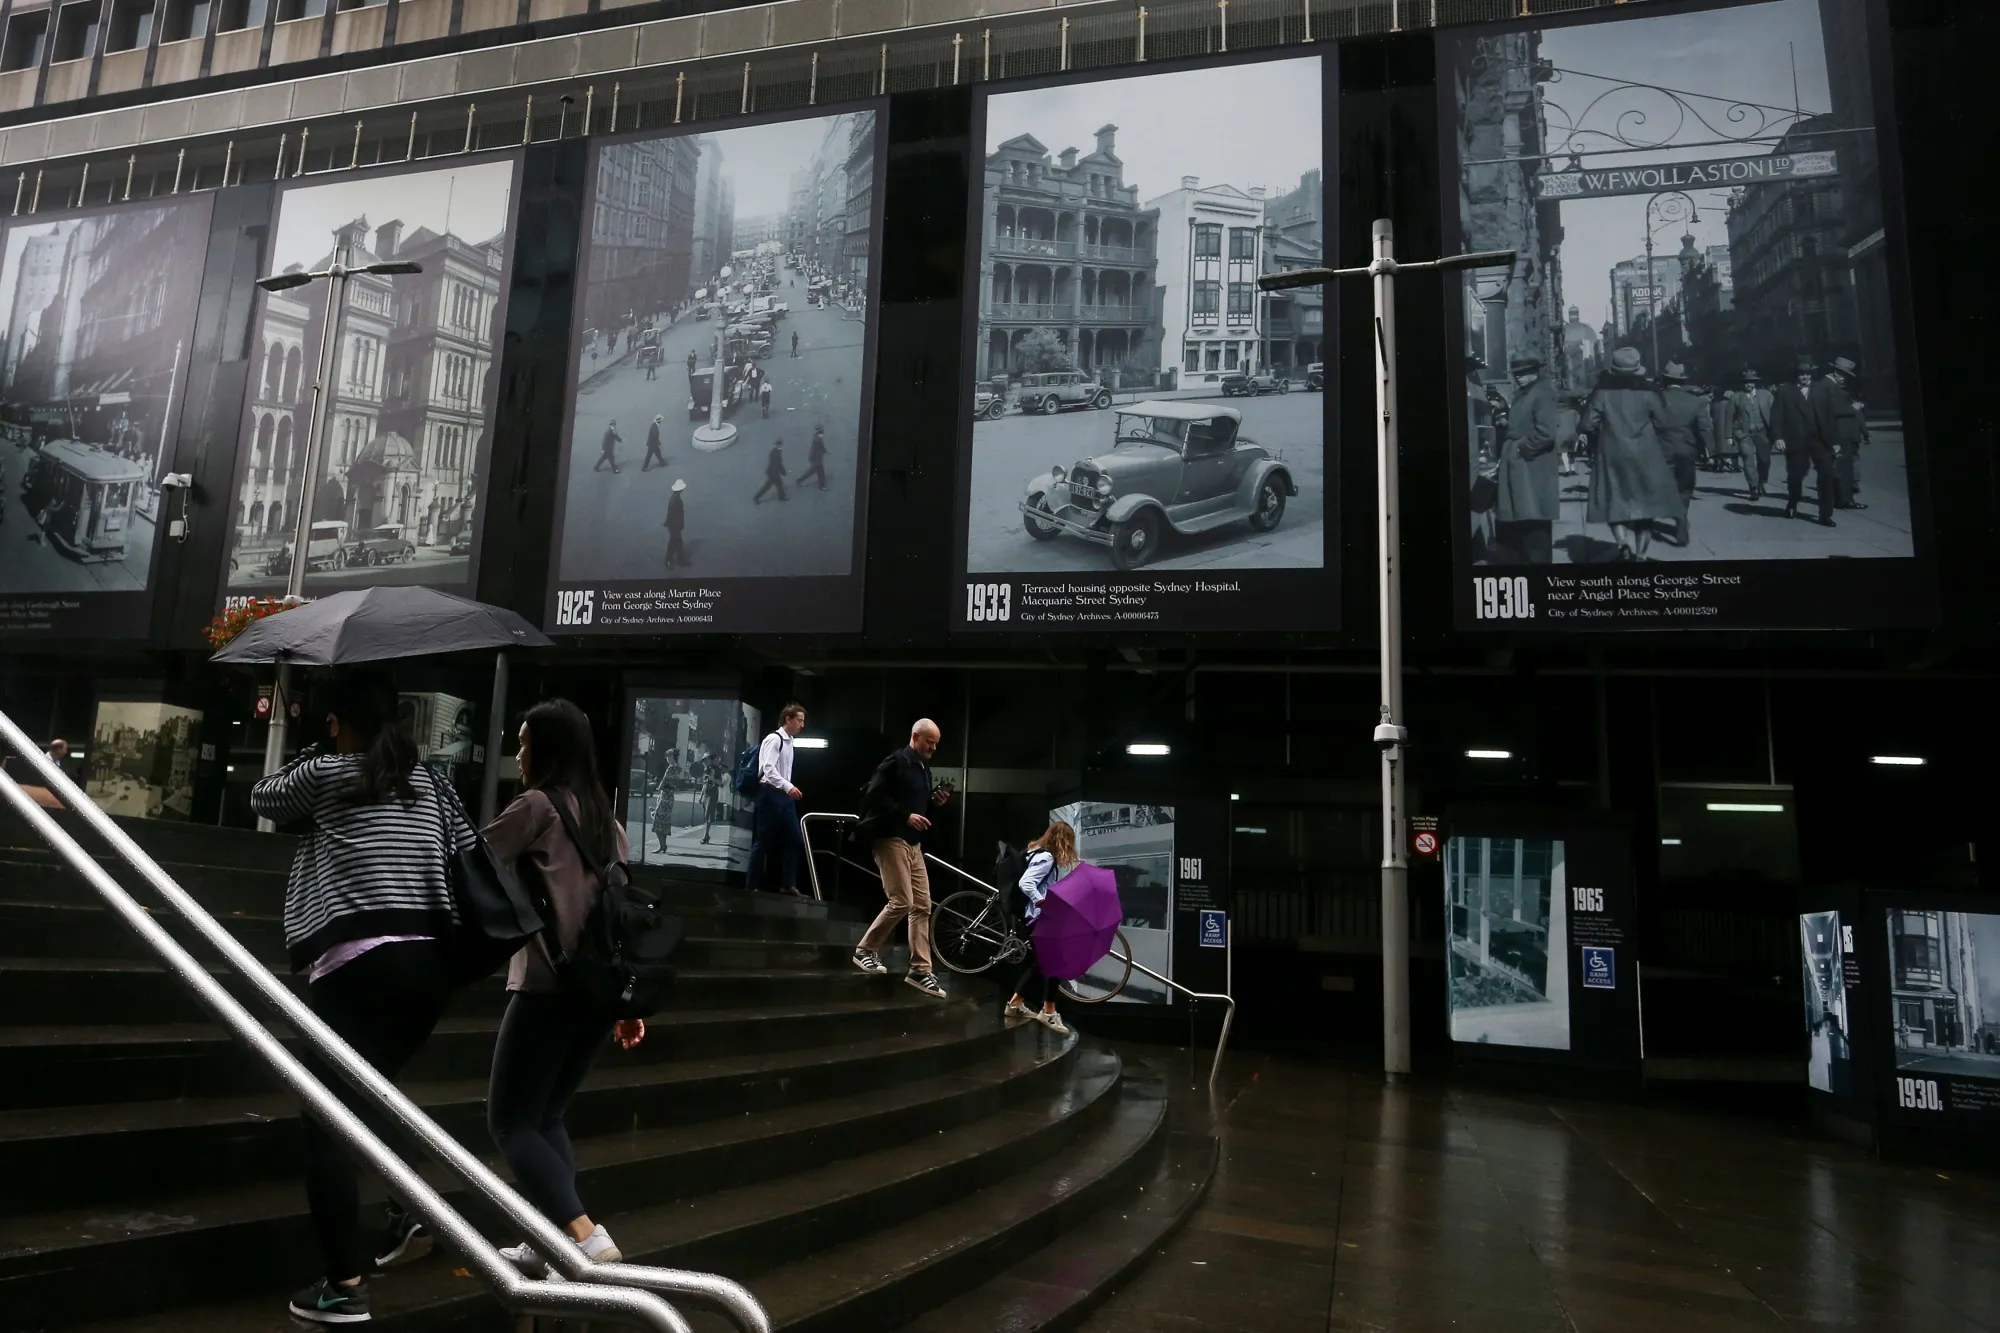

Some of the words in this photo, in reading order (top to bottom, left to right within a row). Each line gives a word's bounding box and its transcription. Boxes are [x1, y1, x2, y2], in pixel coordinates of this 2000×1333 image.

[1547, 576, 1576, 587] View
[1580, 576, 1612, 587] south
[1616, 575, 1651, 588] along
[1654, 574, 1699, 587] George
[1702, 573, 1741, 585] Street
[602, 590, 623, 600] View
[624, 591, 641, 600] east
[643, 590, 666, 601] along
[668, 589, 696, 599] Martin
[699, 588, 721, 598] Place
[1022, 583, 1065, 594] Terraced
[1068, 583, 1106, 595] housing
[1109, 583, 1151, 595] opposite
[1154, 582, 1192, 594] Sydney
[1547, 591, 1574, 601] near
[1578, 589, 1613, 602] Angel
[1618, 588, 1650, 600] Place
[1654, 588, 1700, 601] Sydney
[601, 602, 621, 611] from
[623, 601, 653, 612] George
[655, 600, 680, 610] Street
[682, 600, 714, 611] Sydney
[966, 583, 1011, 622] 1933
[1021, 595, 1072, 607] Macquarie
[1076, 595, 1106, 606] Street
[1109, 594, 1147, 606] Sydney
[556, 590, 595, 625] 1925
[1548, 608, 1566, 618] City
[1570, 607, 1578, 617] of
[1580, 607, 1615, 618] Sydney
[600, 617, 615, 626] City
[615, 616, 621, 625] of
[622, 616, 645, 625] Sydney
[1021, 612, 1036, 622] City
[1037, 612, 1046, 621] of
[1047, 612, 1075, 622] Sydney
[1180, 857, 1202, 880] 1961
[1572, 887, 1604, 912] 1965
